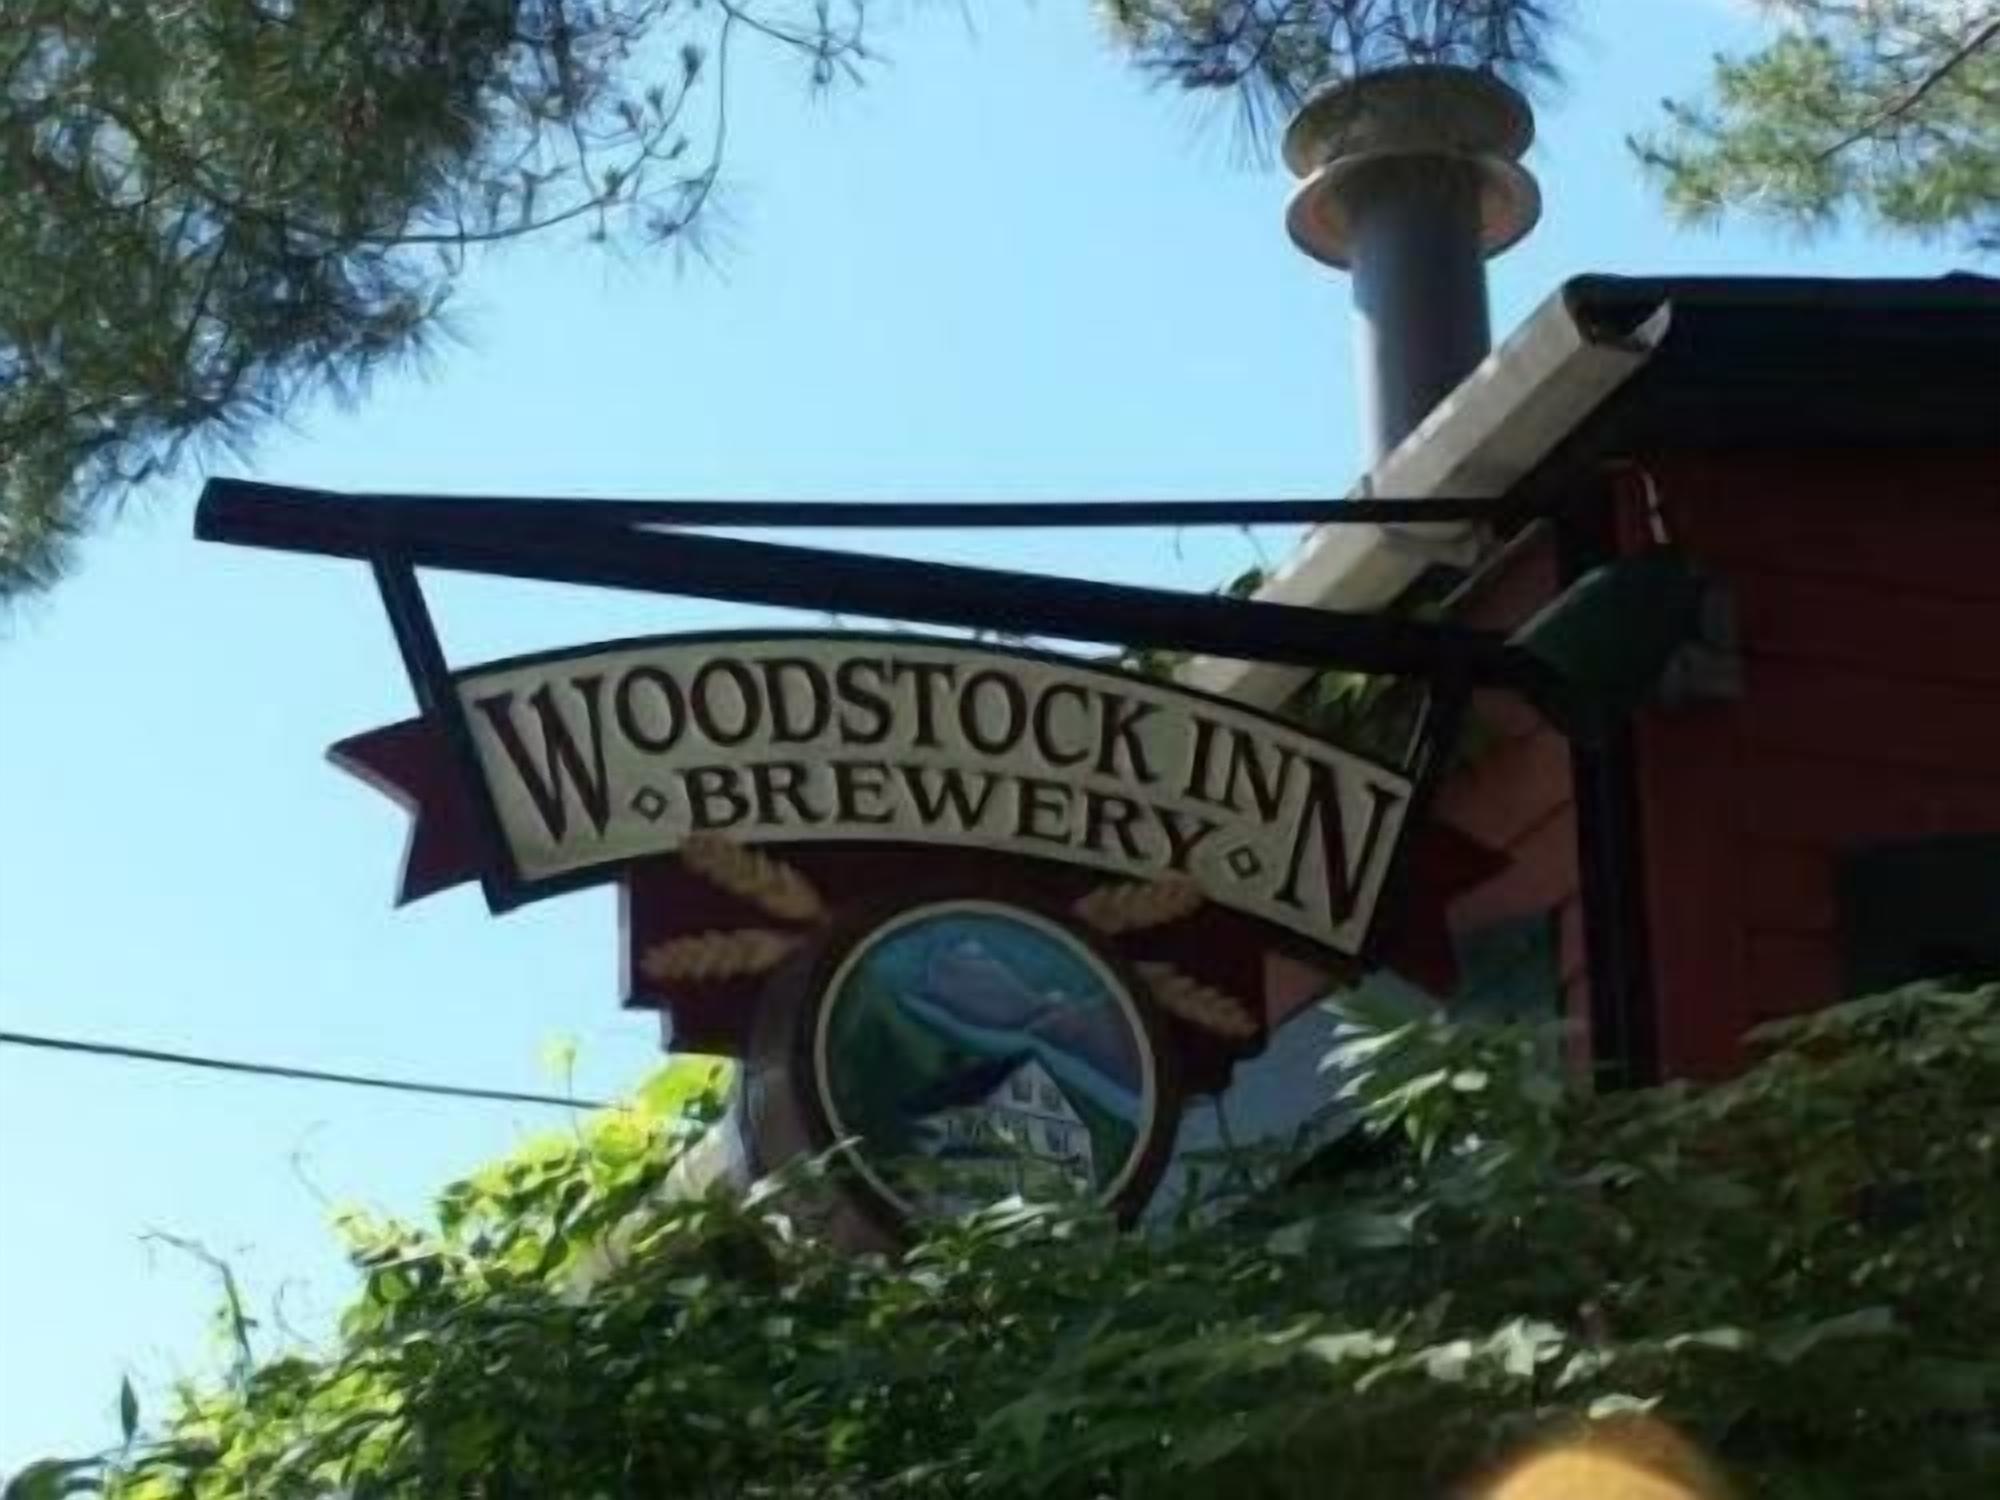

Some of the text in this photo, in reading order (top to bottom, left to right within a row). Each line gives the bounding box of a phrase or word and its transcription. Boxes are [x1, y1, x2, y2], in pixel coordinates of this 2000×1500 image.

[473, 655, 1403, 929] WOODSTOCK INN
[673, 758, 1220, 872] BREWERY
